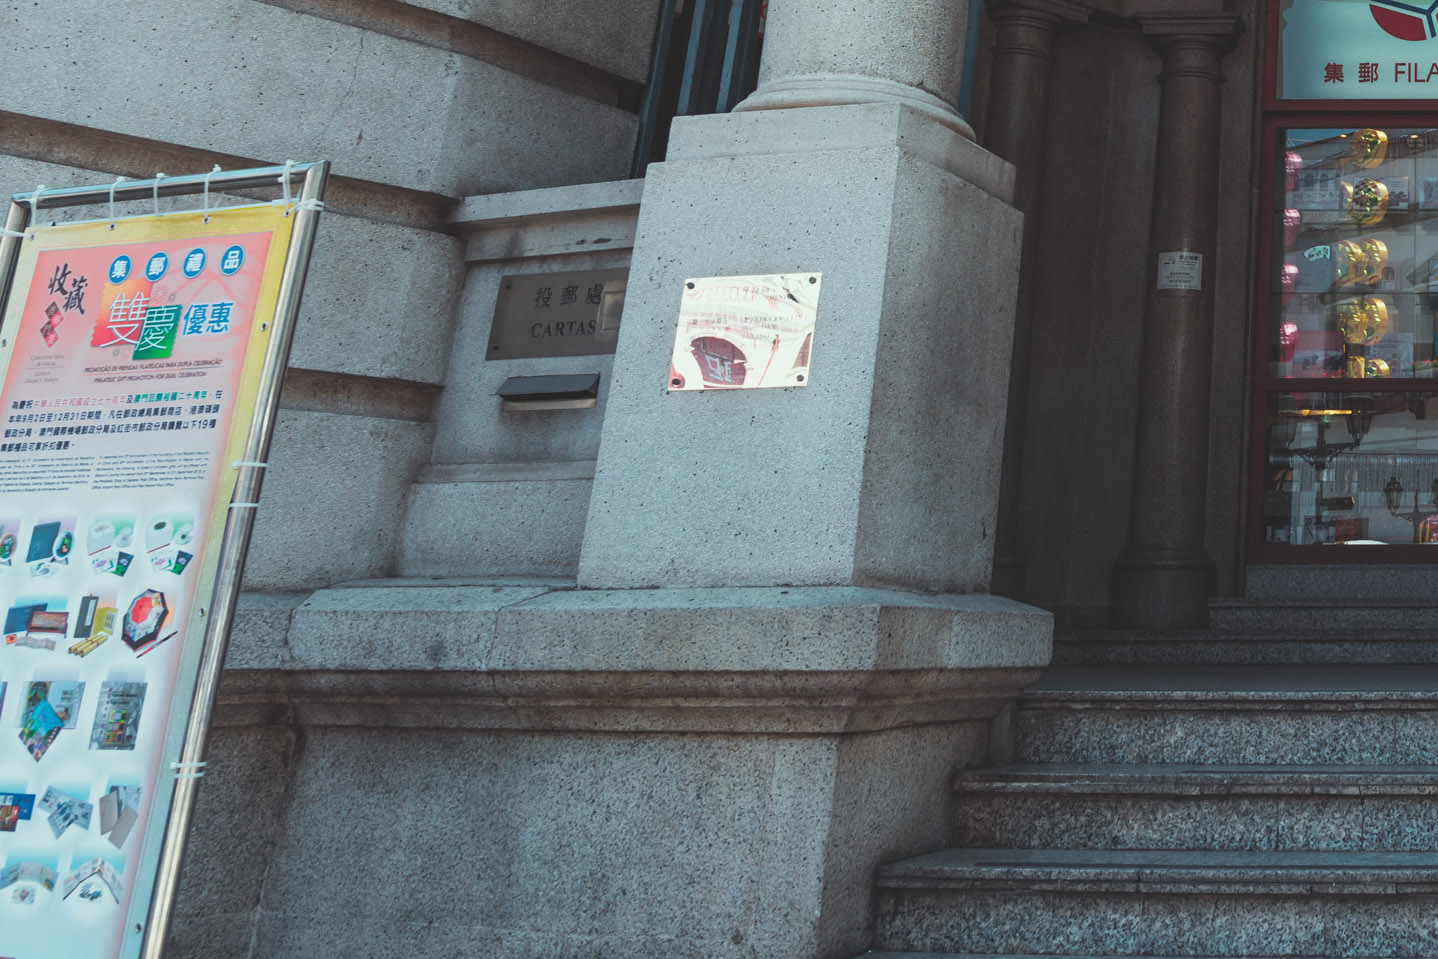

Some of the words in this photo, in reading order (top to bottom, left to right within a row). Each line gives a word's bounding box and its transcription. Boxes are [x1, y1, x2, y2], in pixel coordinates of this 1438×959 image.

[1324, 62, 1378, 84] 集郵
[110, 250, 240, 278] 集郵禮品
[48, 263, 88, 315] 收藏
[534, 284, 604, 308] 投郵處
[182, 302, 234, 336] 優惠
[530, 320, 597, 338] CARTAS
